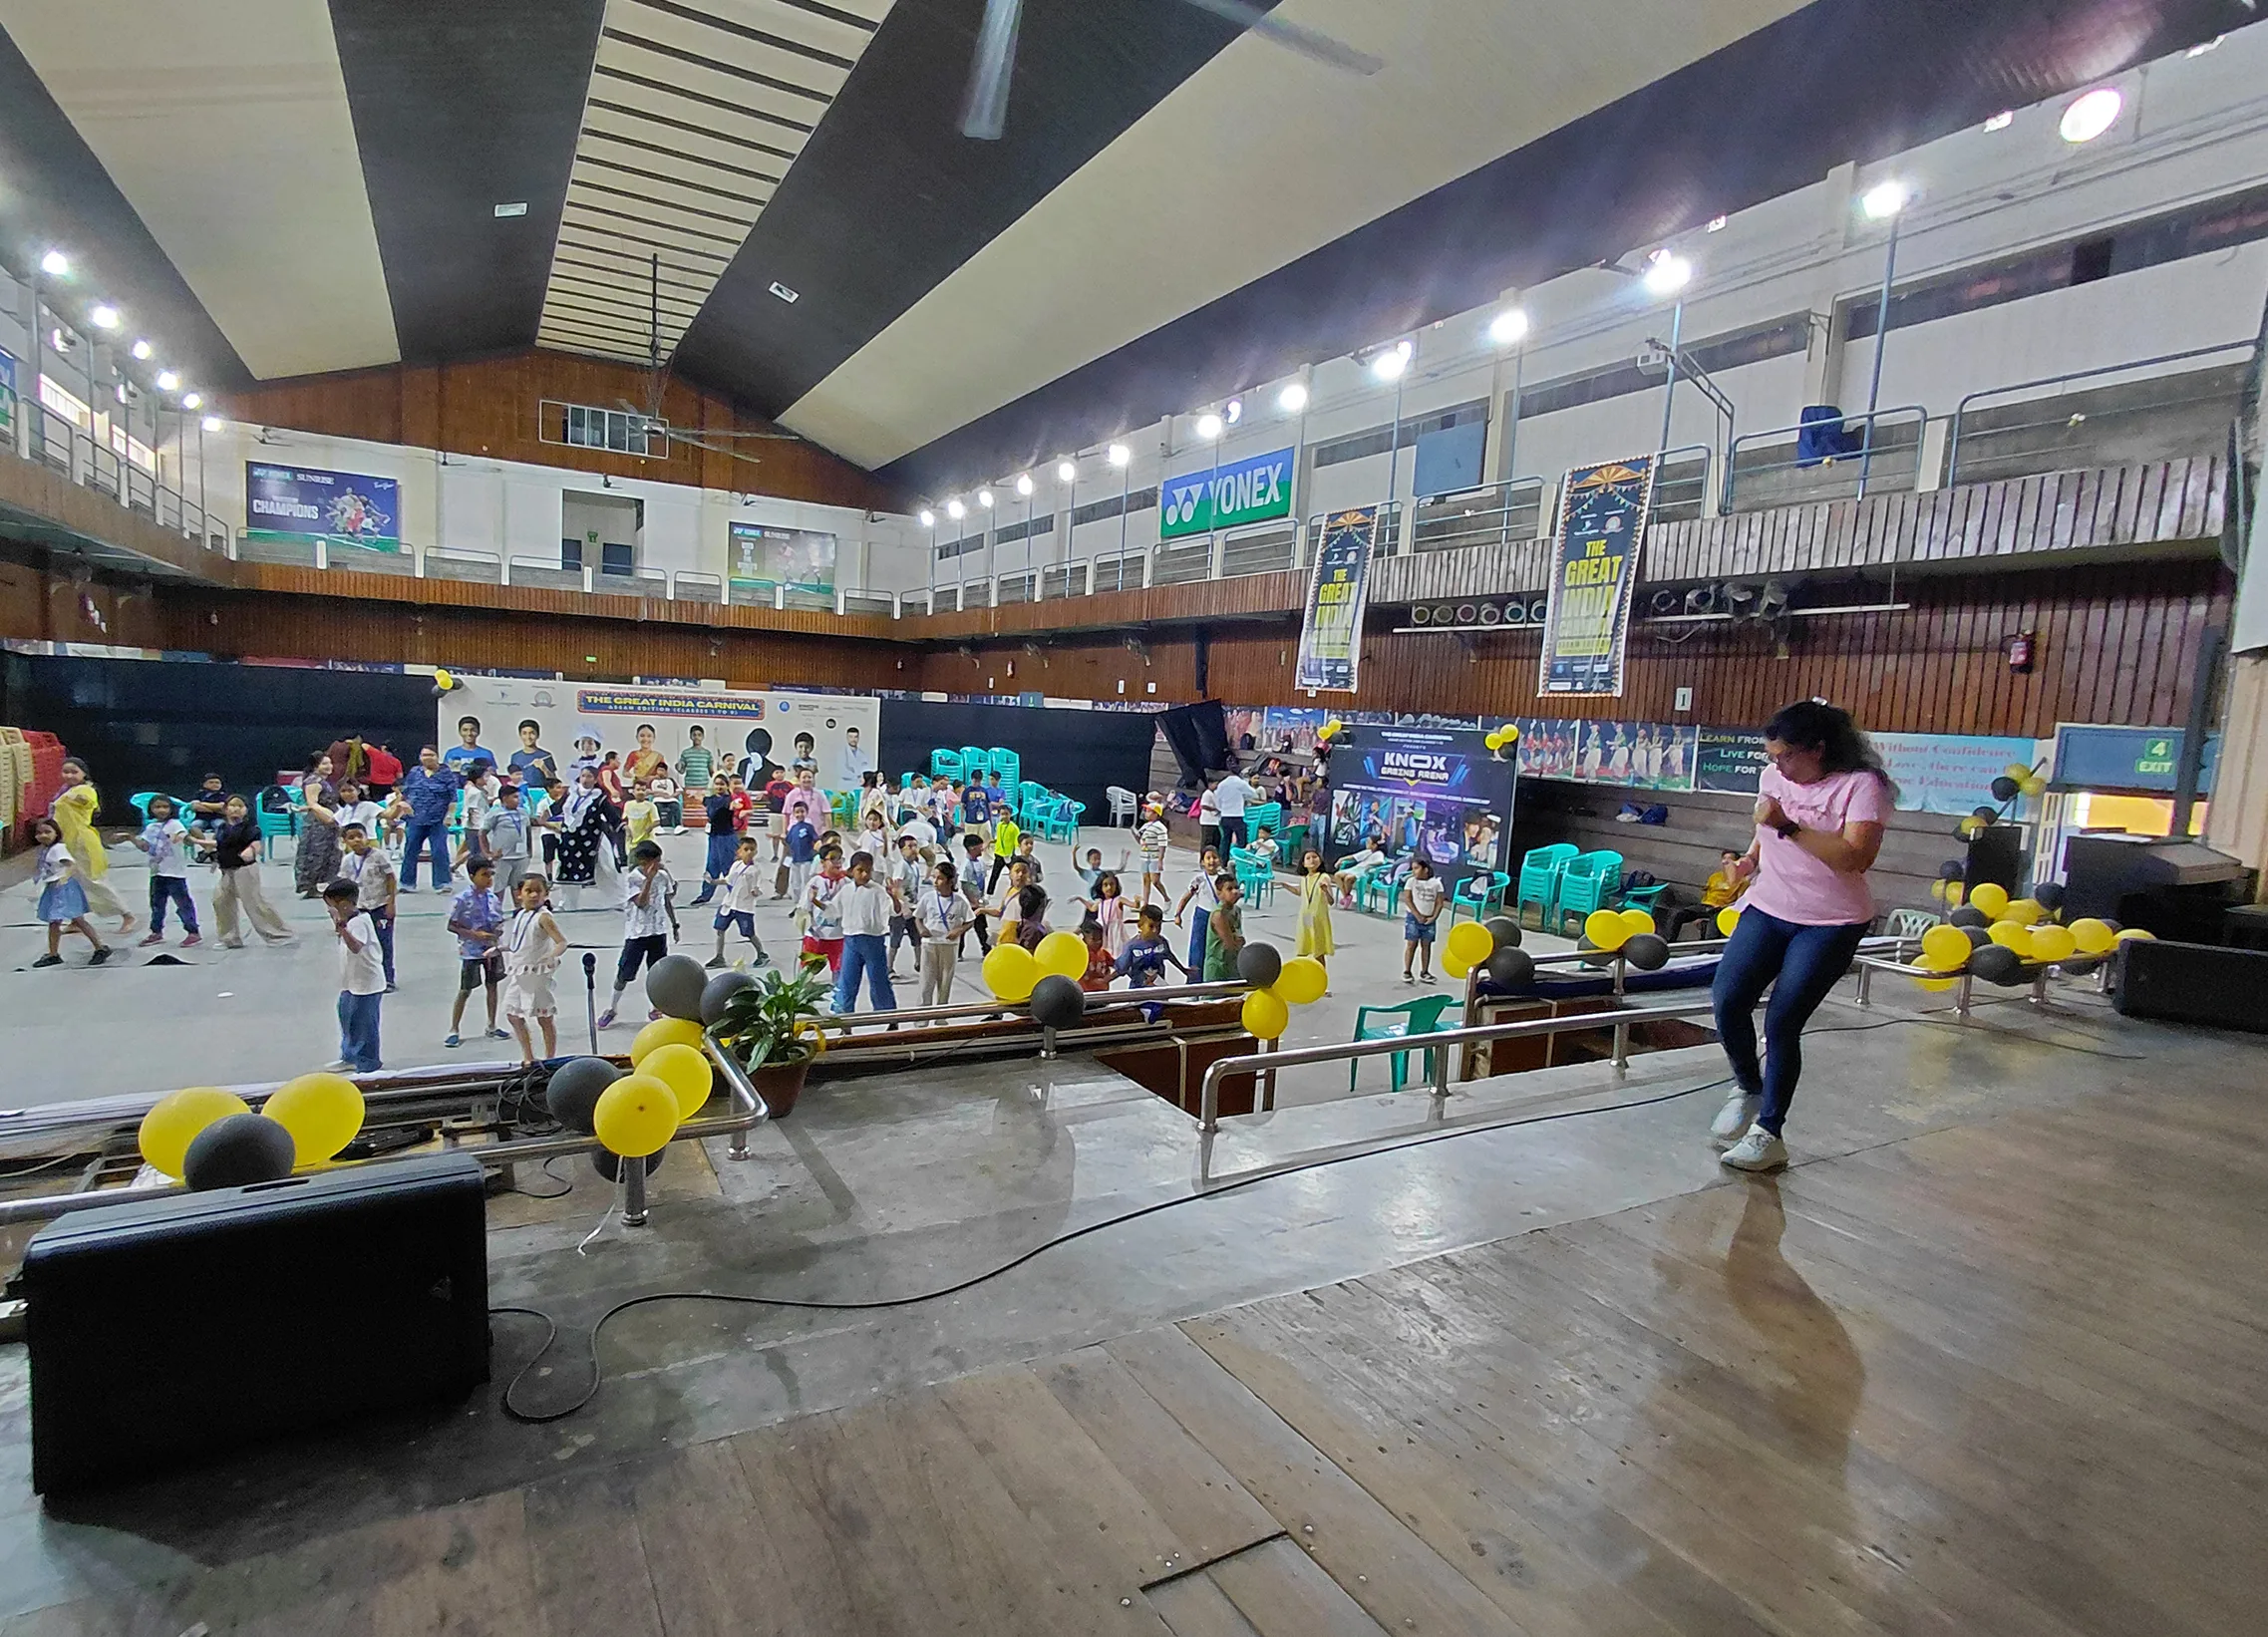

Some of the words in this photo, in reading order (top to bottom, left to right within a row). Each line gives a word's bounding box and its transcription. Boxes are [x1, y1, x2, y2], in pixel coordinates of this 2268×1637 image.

[1208, 463, 1283, 516] YONEX
[252, 498, 319, 520] CHAMPIONS
[1586, 539, 1607, 557] THE
[1333, 568, 1348, 582] THE
[1564, 555, 1623, 587] GREAT
[1319, 582, 1358, 604] GREAT
[1560, 585, 1616, 618] INDIA
[585, 695, 612, 704] THE
[613, 697, 658, 706] GREAT
[659, 699, 695, 709] INDIA
[697, 700, 760, 711] CARNIVAL
[1681, 693, 1686, 707] 1
[1699, 733, 1735, 744] LEARN
[1720, 749, 1746, 759] LIVE
[1932, 746, 2015, 757] Confidence
[2151, 741, 2167, 756] 4
[1384, 752, 1447, 771] KNOX
[1703, 762, 1733, 774] HOPE
[1735, 765, 1757, 775] FOR
[1930, 762, 1968, 772] there
[2138, 761, 2172, 773] EXIT
[1381, 767, 1416, 778] GAMING
[1418, 770, 1450, 781] ARENA
